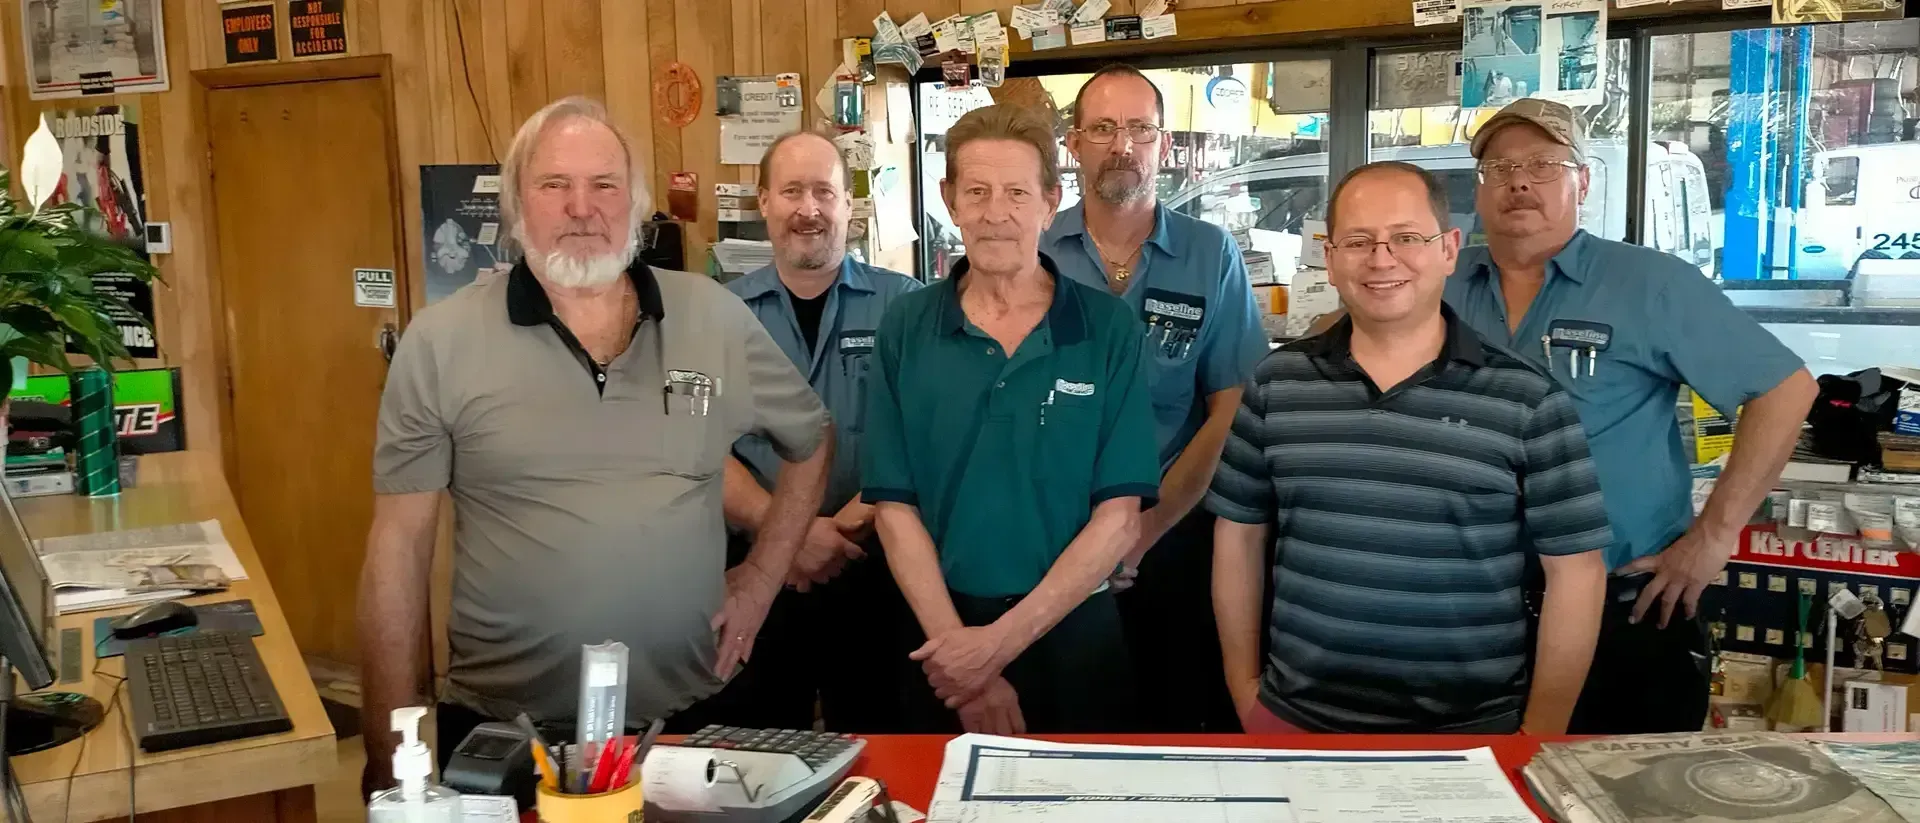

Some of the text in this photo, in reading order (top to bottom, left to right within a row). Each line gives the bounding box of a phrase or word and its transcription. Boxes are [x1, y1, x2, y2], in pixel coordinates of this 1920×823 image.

[307, 1, 322, 13] NOT
[225, 14, 272, 34] EMPLOYEES
[292, 12, 341, 28] RESPONSIBLE
[310, 27, 326, 39] FOR
[238, 37, 259, 53] ONLY
[295, 38, 344, 54] ACCIDENTS
[744, 92, 774, 101] CREDIT
[55, 113, 126, 139] ROADSIDE
[357, 271, 391, 282] PULL
[1751, 531, 1800, 557] KEY
[1802, 535, 1900, 567] CENTER
[1592, 740, 1692, 751] SAFETY
